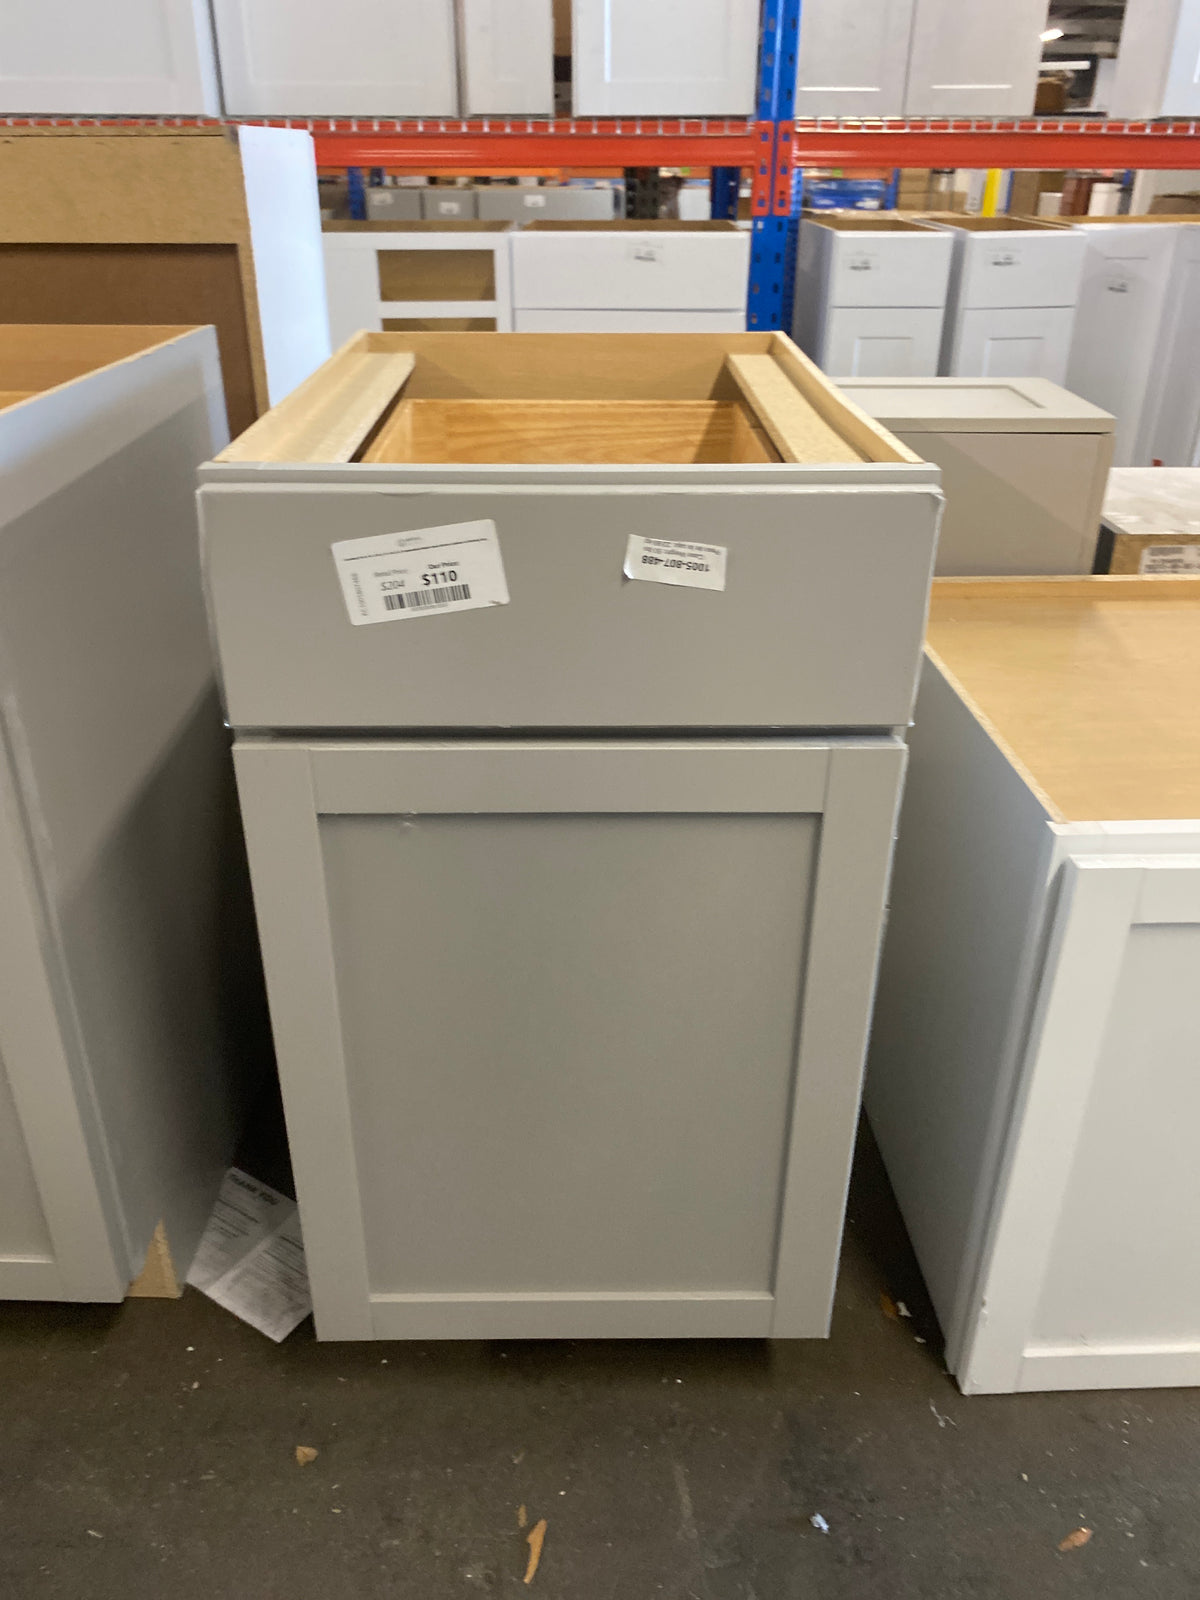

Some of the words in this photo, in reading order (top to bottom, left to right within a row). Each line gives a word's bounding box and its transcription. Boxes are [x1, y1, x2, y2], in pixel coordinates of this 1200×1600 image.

[641, 555, 710, 572] 1005-807-488
[380, 579, 406, 592] $204
[421, 570, 458, 587] $110
